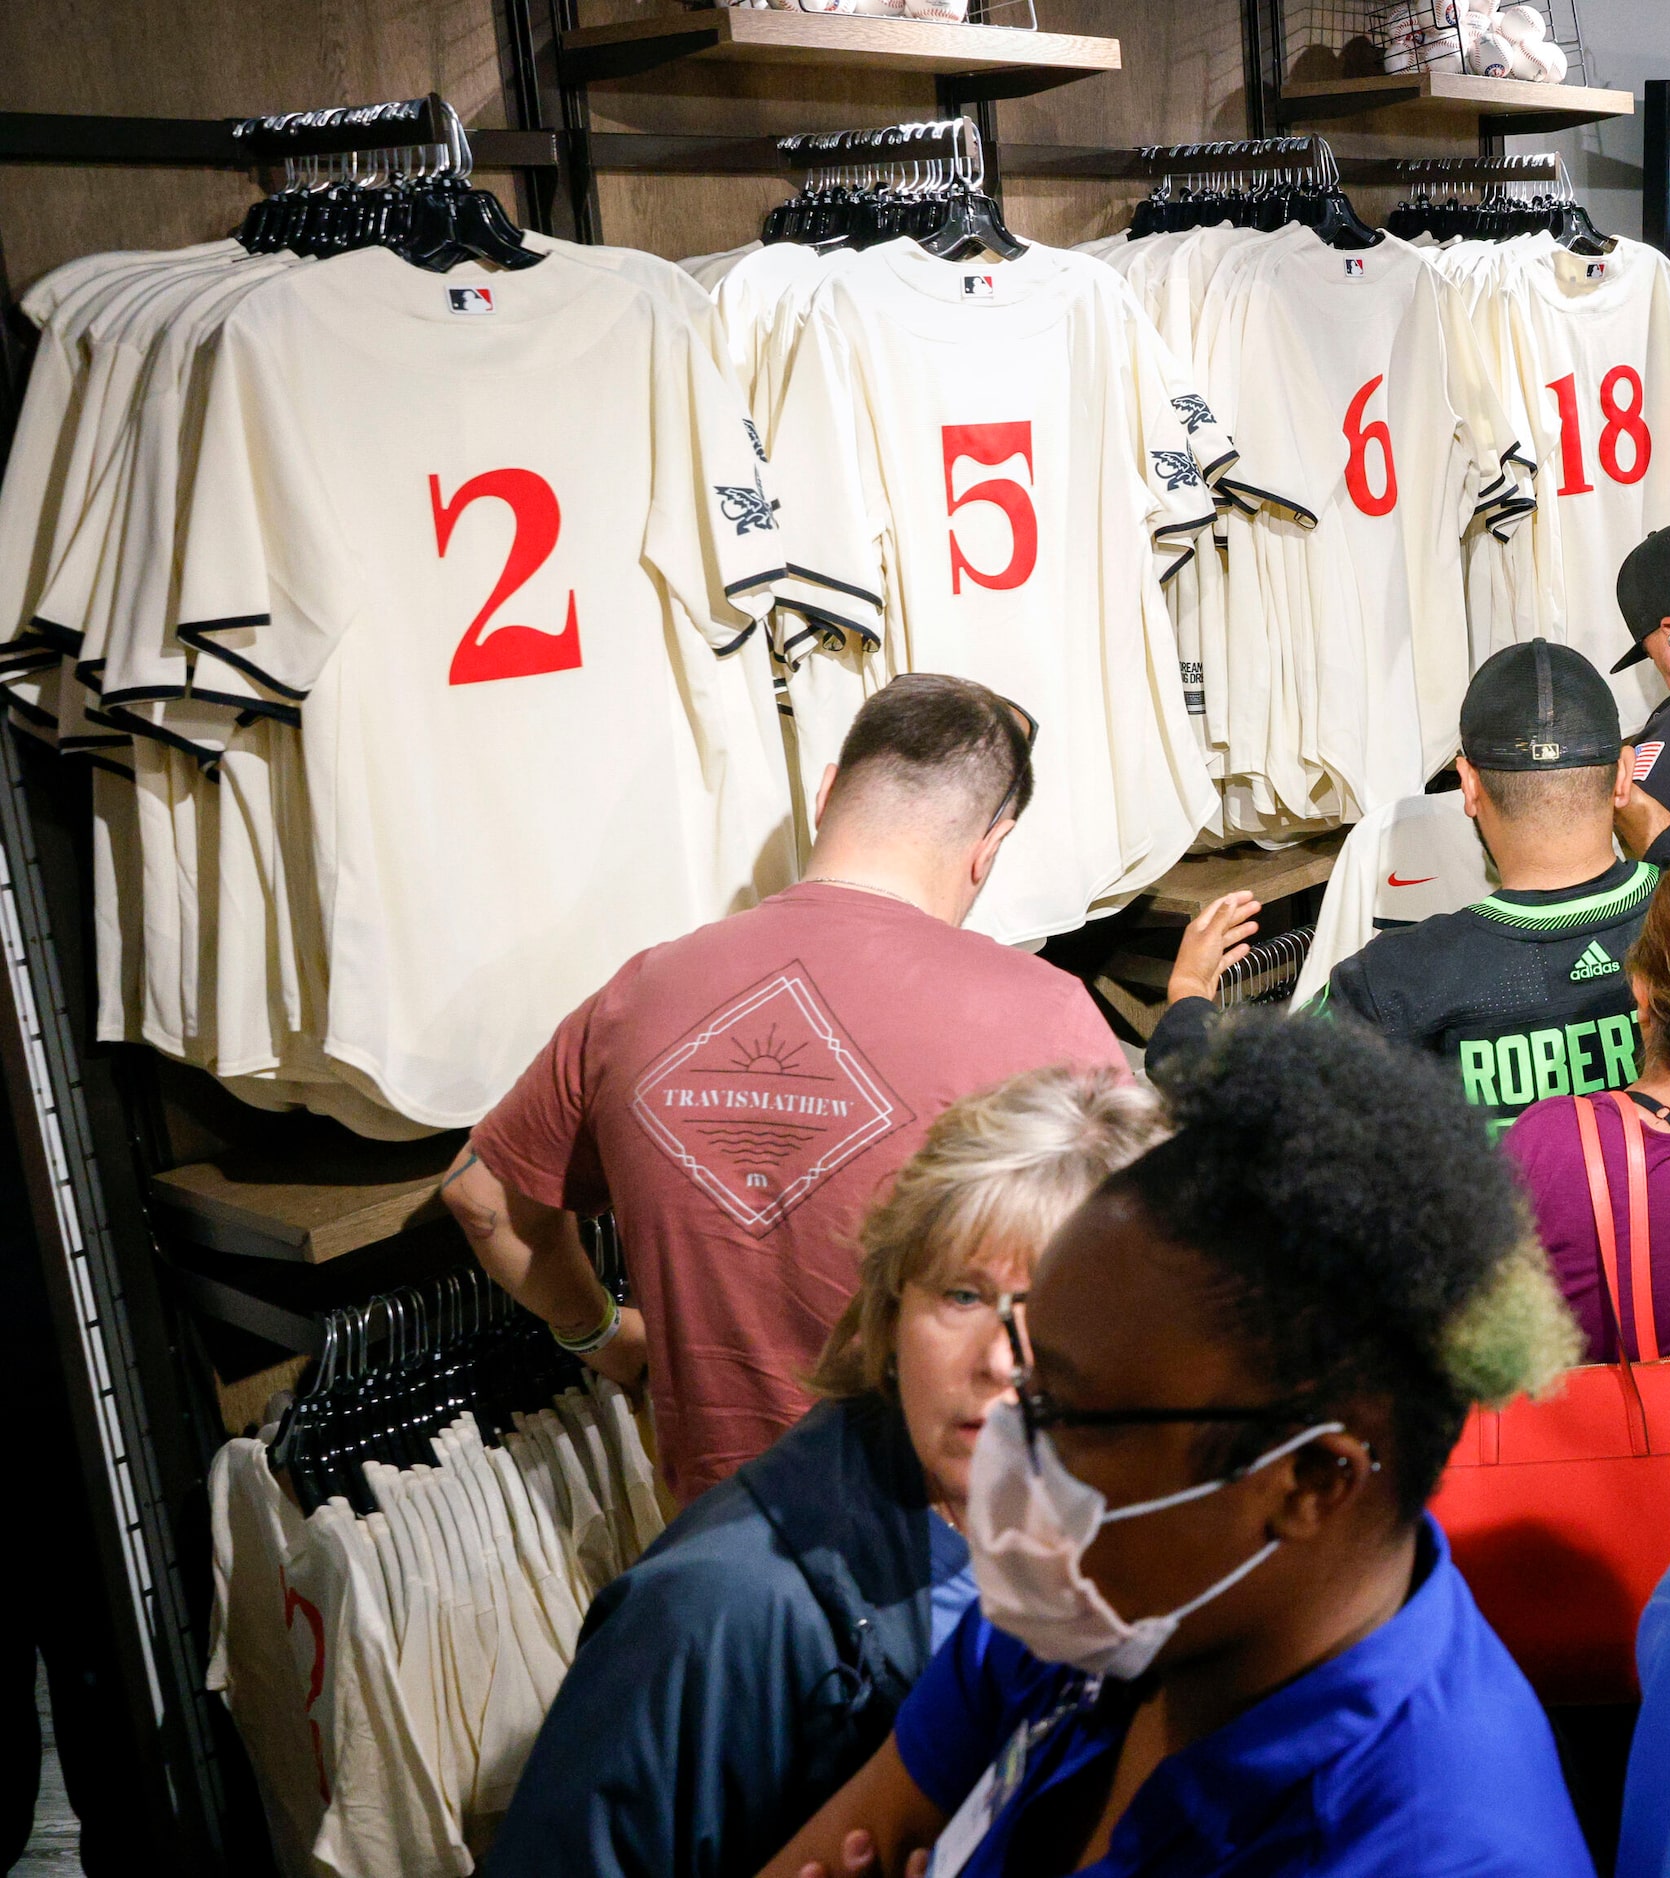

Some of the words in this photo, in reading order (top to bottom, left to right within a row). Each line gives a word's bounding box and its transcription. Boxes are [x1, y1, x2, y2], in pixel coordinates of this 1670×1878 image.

[1343, 374, 1398, 517] 6
[1546, 365, 1652, 497] 18
[941, 421, 1038, 595] 5
[428, 468, 583, 686] 2
[1570, 961, 1620, 981] adidas
[663, 1089, 850, 1117] TRAVISMATHEW
